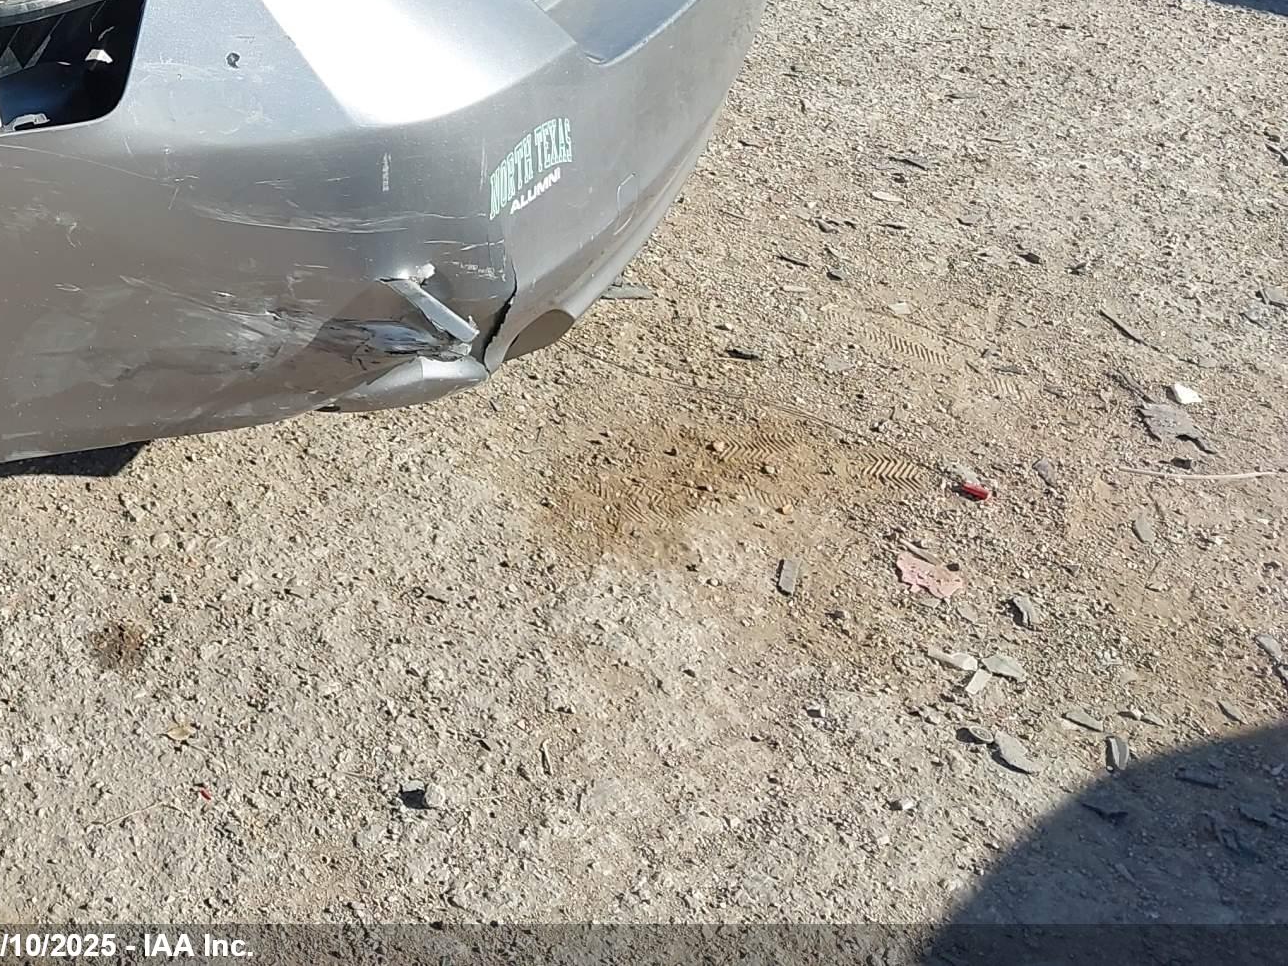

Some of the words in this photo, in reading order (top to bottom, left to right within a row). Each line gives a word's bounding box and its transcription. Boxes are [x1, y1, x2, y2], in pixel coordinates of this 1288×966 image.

[490, 133, 533, 220] NORTH
[534, 118, 572, 172] TEXAS
[509, 167, 561, 215] ALUMNI
